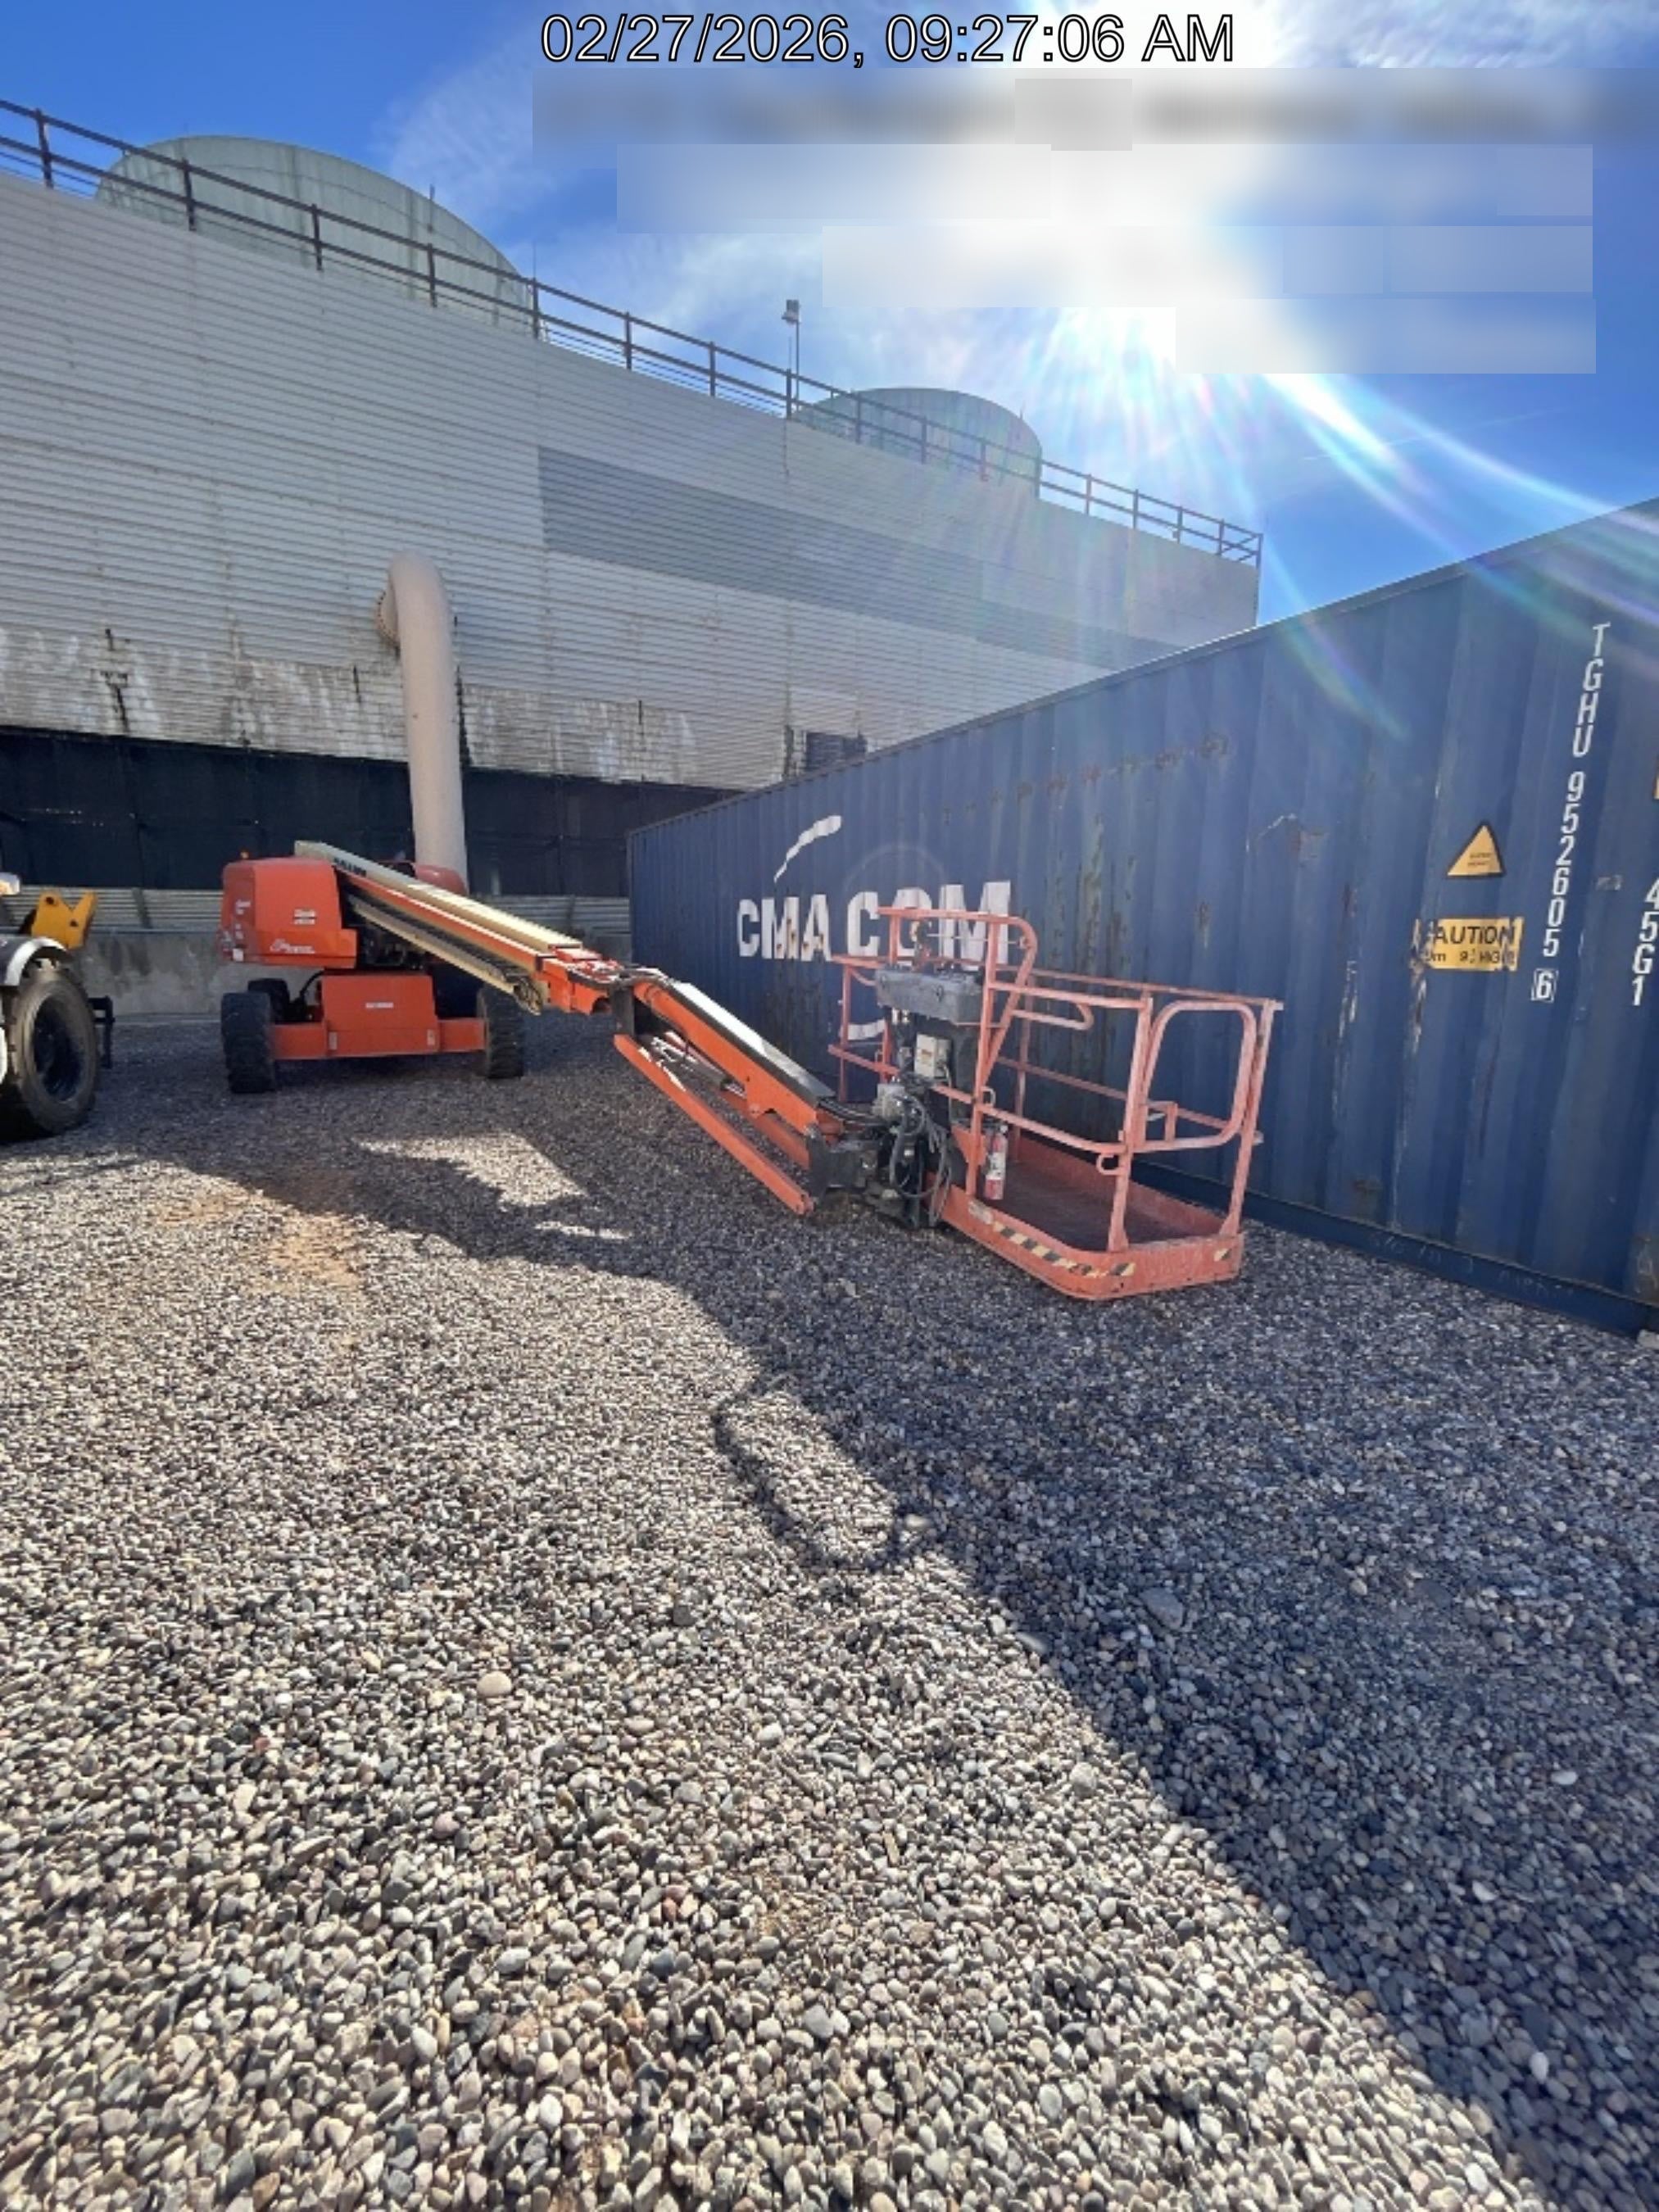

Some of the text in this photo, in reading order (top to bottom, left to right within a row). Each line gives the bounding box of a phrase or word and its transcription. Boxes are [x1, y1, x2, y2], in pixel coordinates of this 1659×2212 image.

[1534, 621, 1611, 1001] TGHU 952605 6
[737, 894, 834, 963] CMA
[1431, 926, 1516, 946] AUTION
